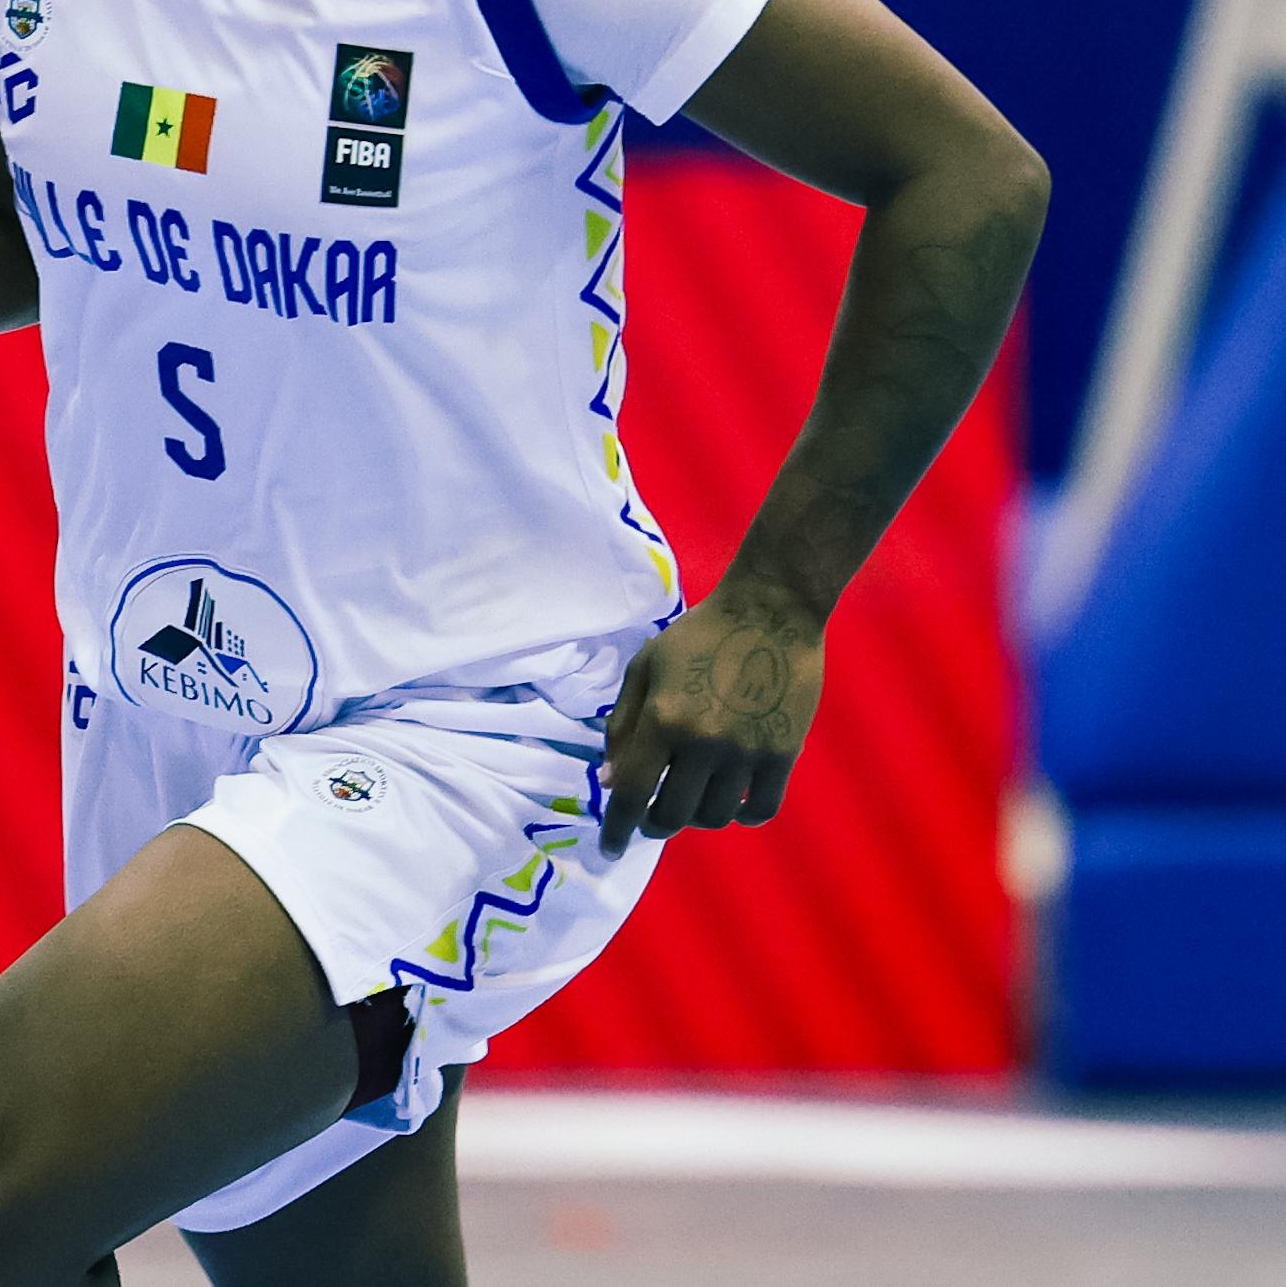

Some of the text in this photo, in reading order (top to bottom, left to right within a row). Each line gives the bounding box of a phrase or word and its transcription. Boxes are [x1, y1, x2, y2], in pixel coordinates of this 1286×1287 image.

[335, 137, 391, 169] FIBA
[127, 198, 201, 293] DE
[212, 219, 398, 327] DAKAR
[141, 657, 273, 725] KEBIMO
